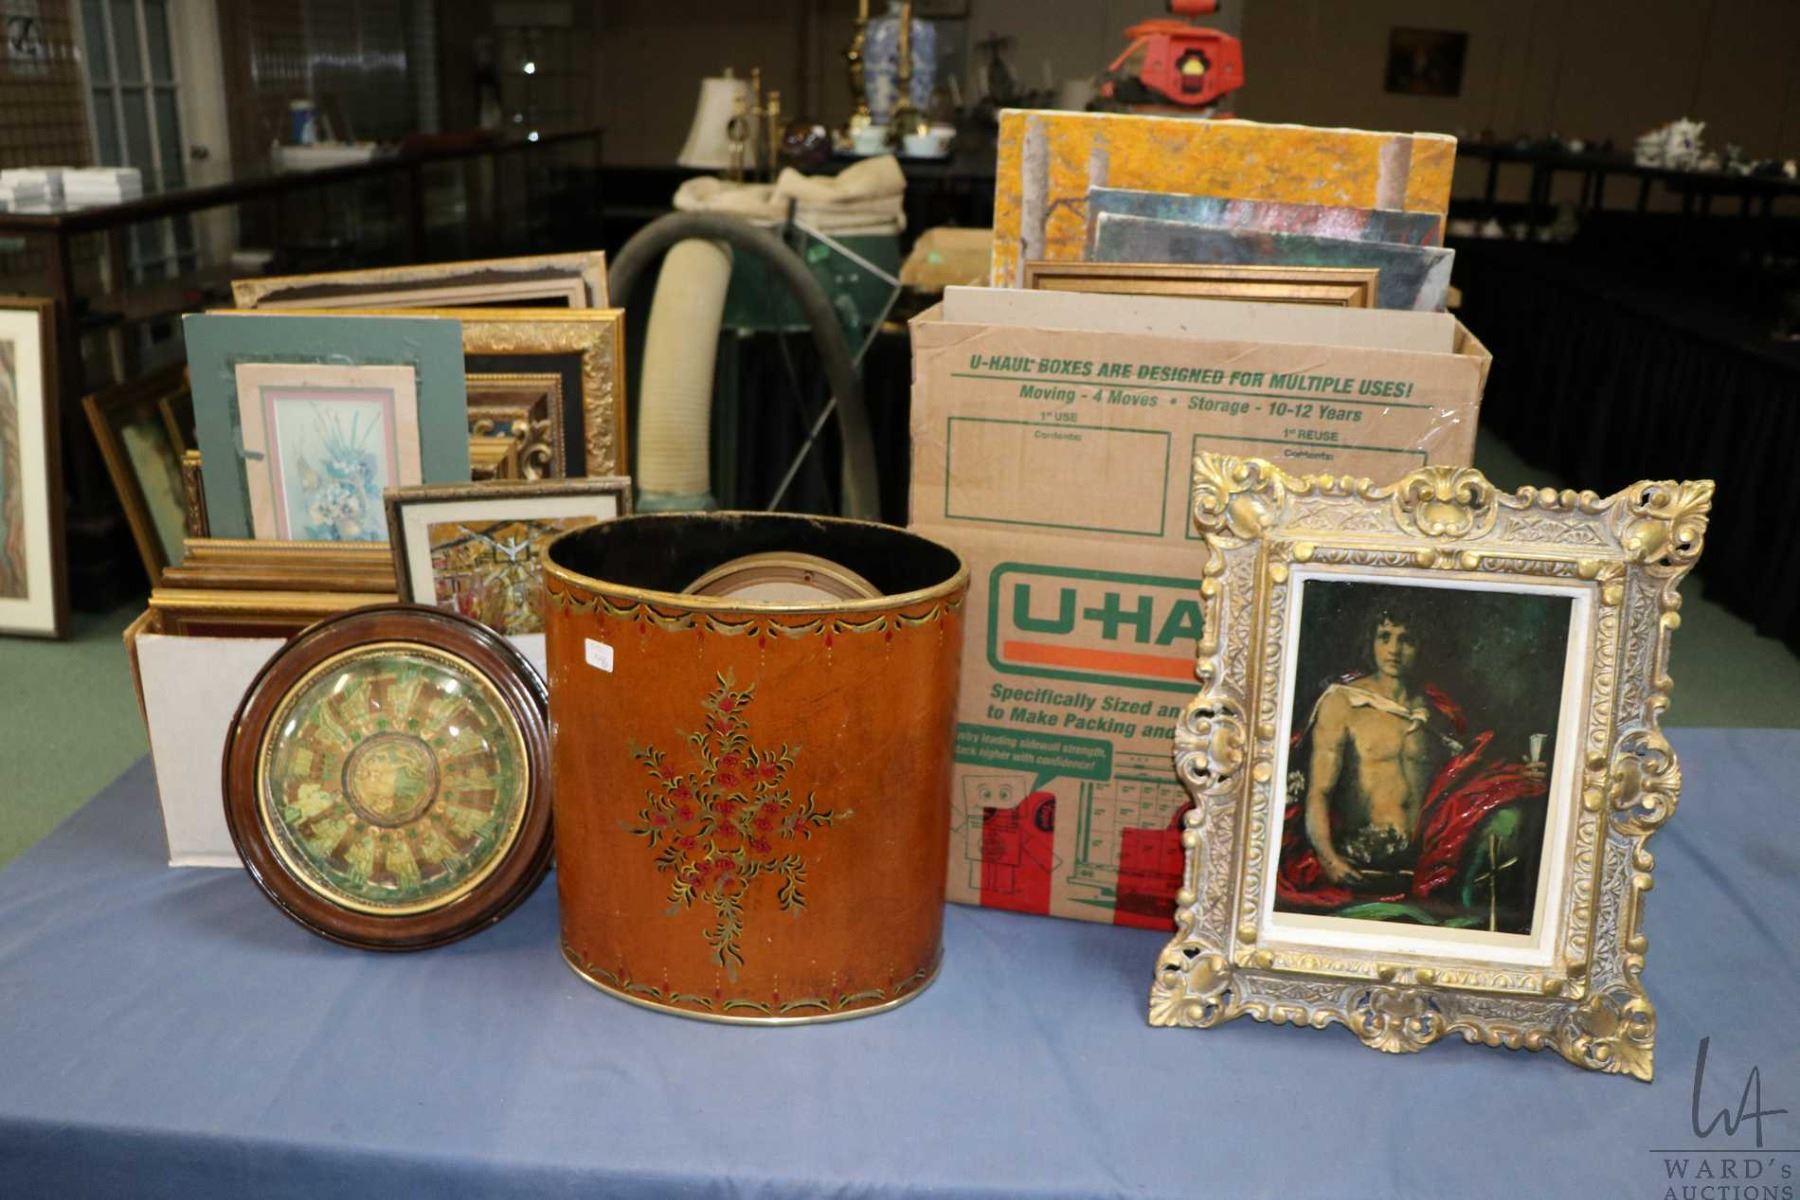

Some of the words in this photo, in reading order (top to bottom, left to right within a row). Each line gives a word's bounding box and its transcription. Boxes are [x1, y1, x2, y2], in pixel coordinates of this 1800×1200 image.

[1038, 358, 1093, 376] BOXES
[1098, 362, 1132, 378] ARE
[1137, 364, 1224, 385] DESIGNED
[1229, 371, 1264, 388] FOR
[1269, 373, 1355, 394] MULTIPLE
[1358, 379, 1414, 398] USES!
[1019, 384, 1075, 404] Moving
[1093, 389, 1103, 403] 4
[1107, 390, 1158, 407] Moves
[1188, 395, 1249, 416] Storage
[1269, 402, 1312, 418] 10-12
[1319, 405, 1362, 422] Years
[1055, 411, 1078, 422] USE
[1297, 429, 1338, 441] REUSE
[1013, 584, 1205, 646] U-HA
[990, 683, 1096, 712] Specifically
[1101, 696, 1153, 715] Sized
[1157, 704, 1180, 718] an
[987, 705, 1004, 720] to
[1009, 706, 1058, 726] Make
[1063, 713, 1136, 738] Packing
